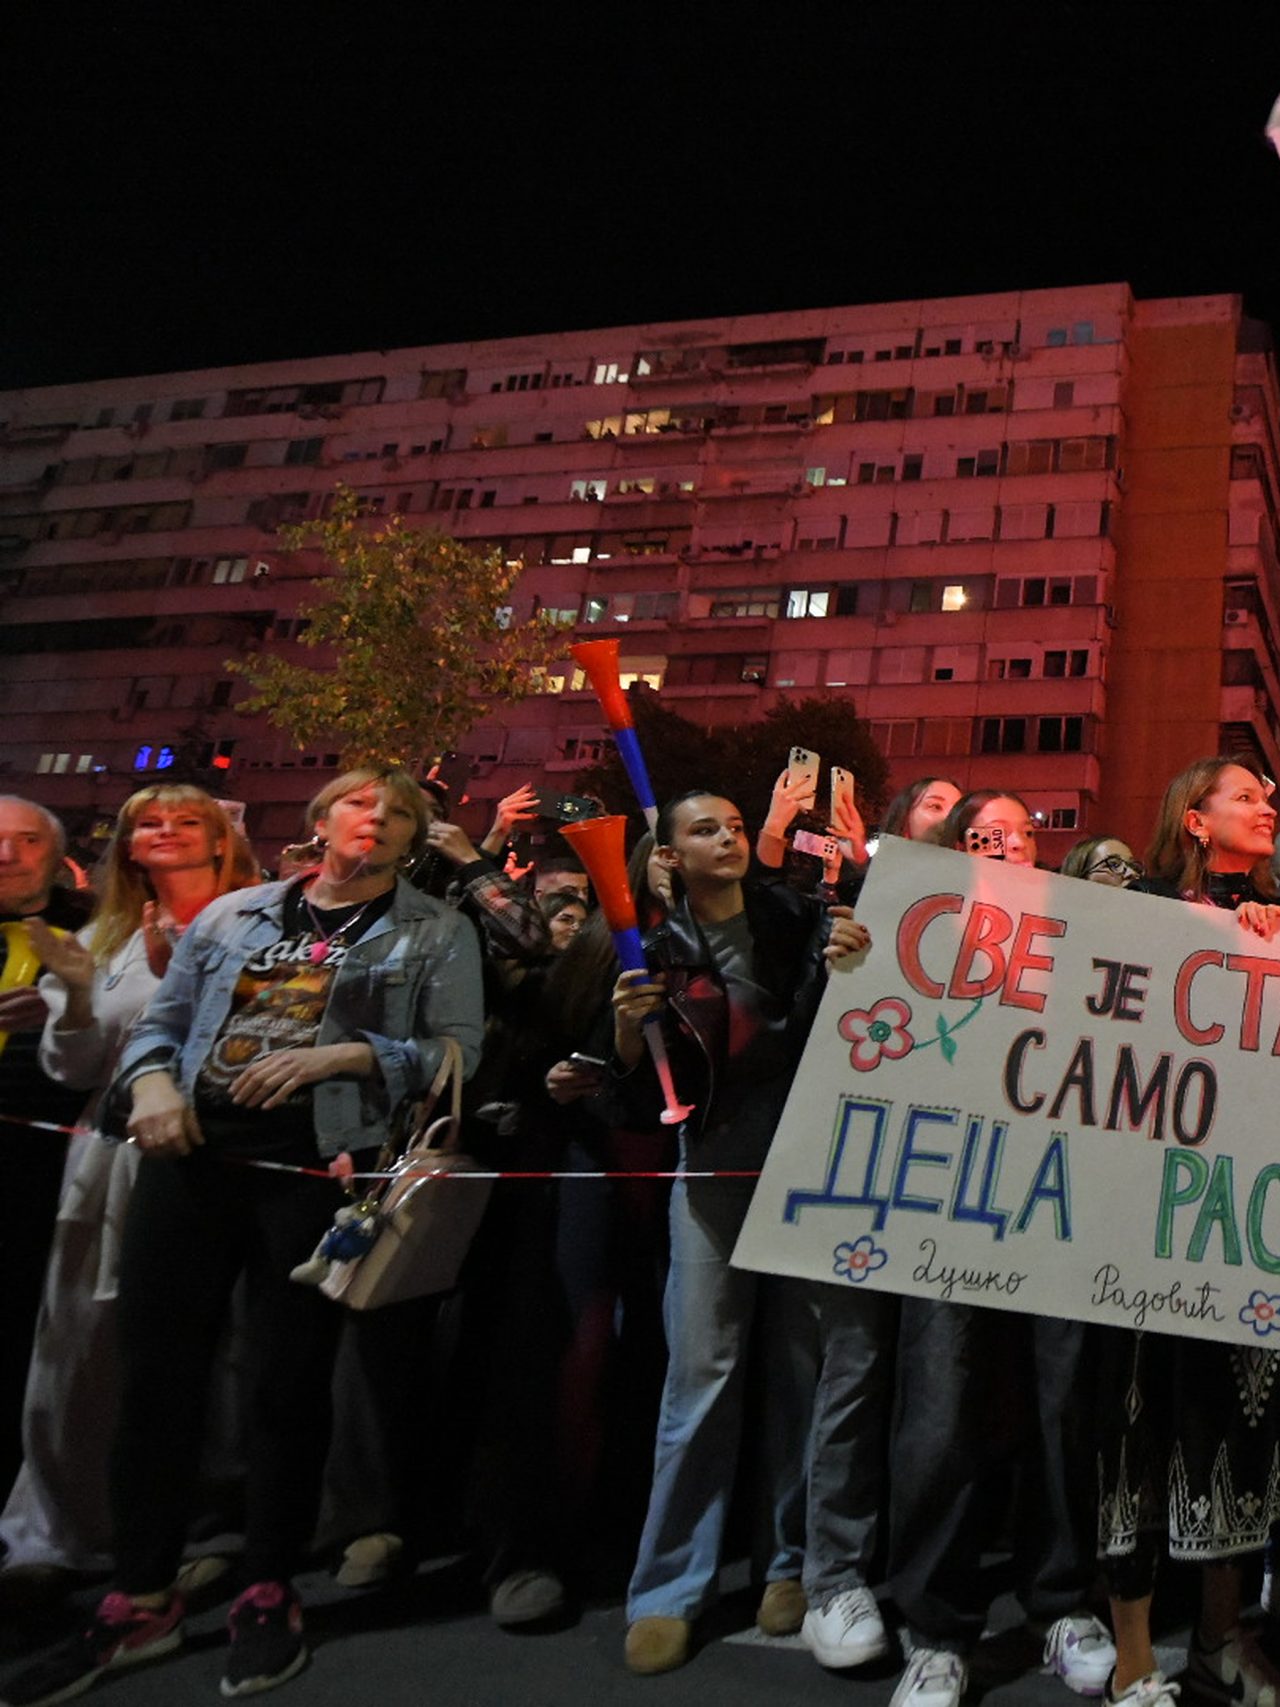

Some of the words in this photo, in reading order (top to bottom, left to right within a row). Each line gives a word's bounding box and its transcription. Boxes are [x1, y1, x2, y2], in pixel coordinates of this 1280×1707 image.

[896, 892, 1067, 1013] СВЕ
[1085, 957, 1153, 1022] ЈЕ
[1004, 1026, 1217, 1146] САМО
[782, 1093, 1073, 1242] ДЕЦА
[912, 1238, 1028, 1298] Душко
[1090, 1263, 1226, 1327] Радовић
